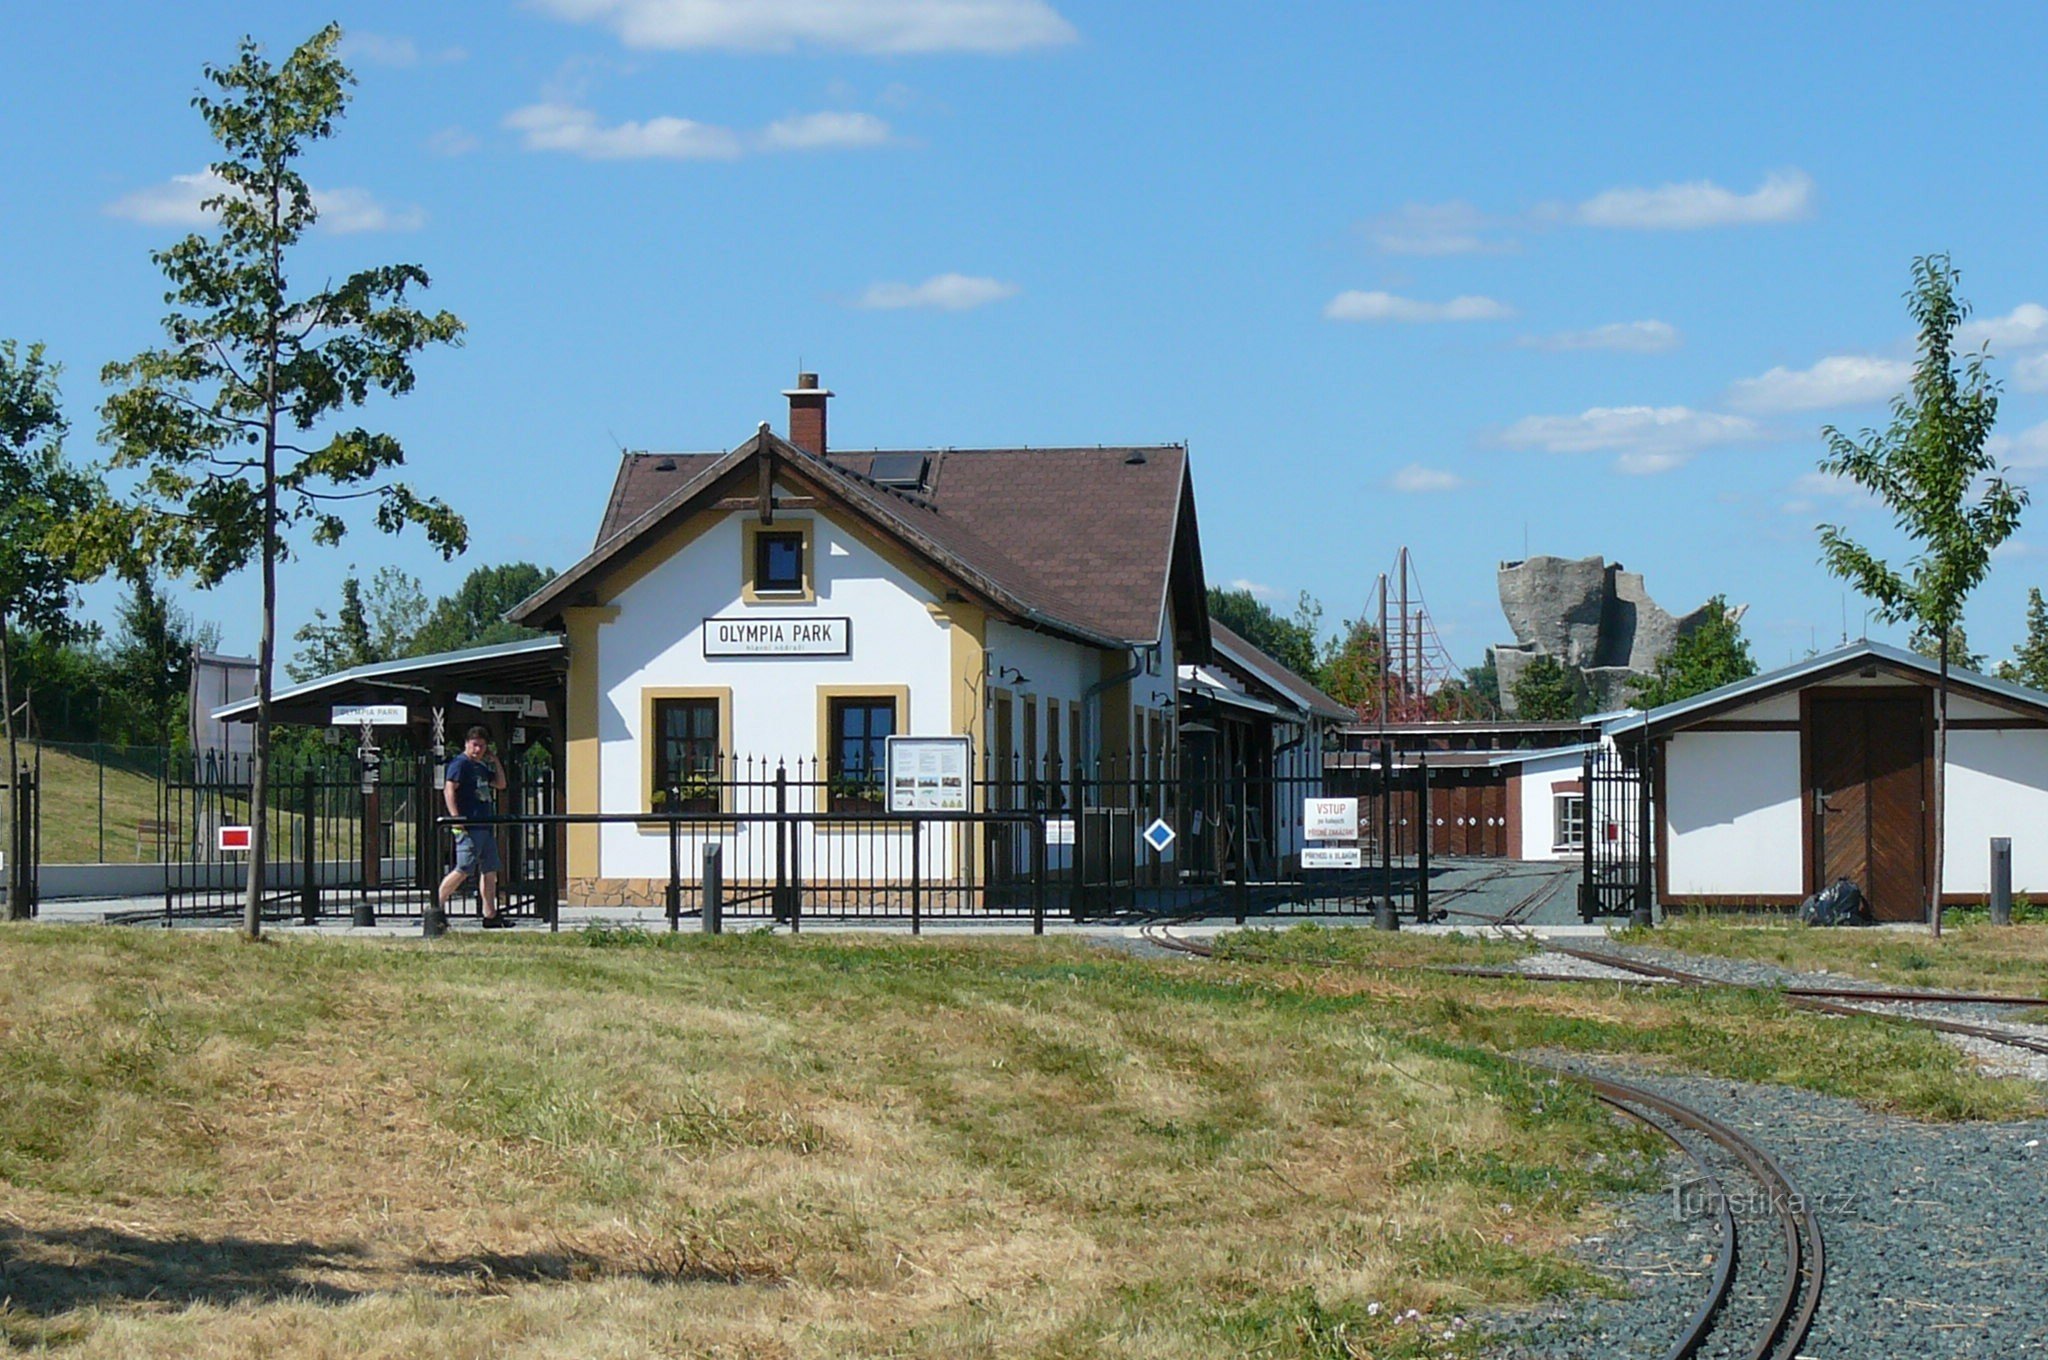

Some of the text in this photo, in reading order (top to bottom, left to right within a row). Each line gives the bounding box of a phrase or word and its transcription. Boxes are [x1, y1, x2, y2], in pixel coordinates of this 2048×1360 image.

[719, 624, 832, 642] OLYMPIA PARK
[1317, 803, 1346, 814] VSTUP
